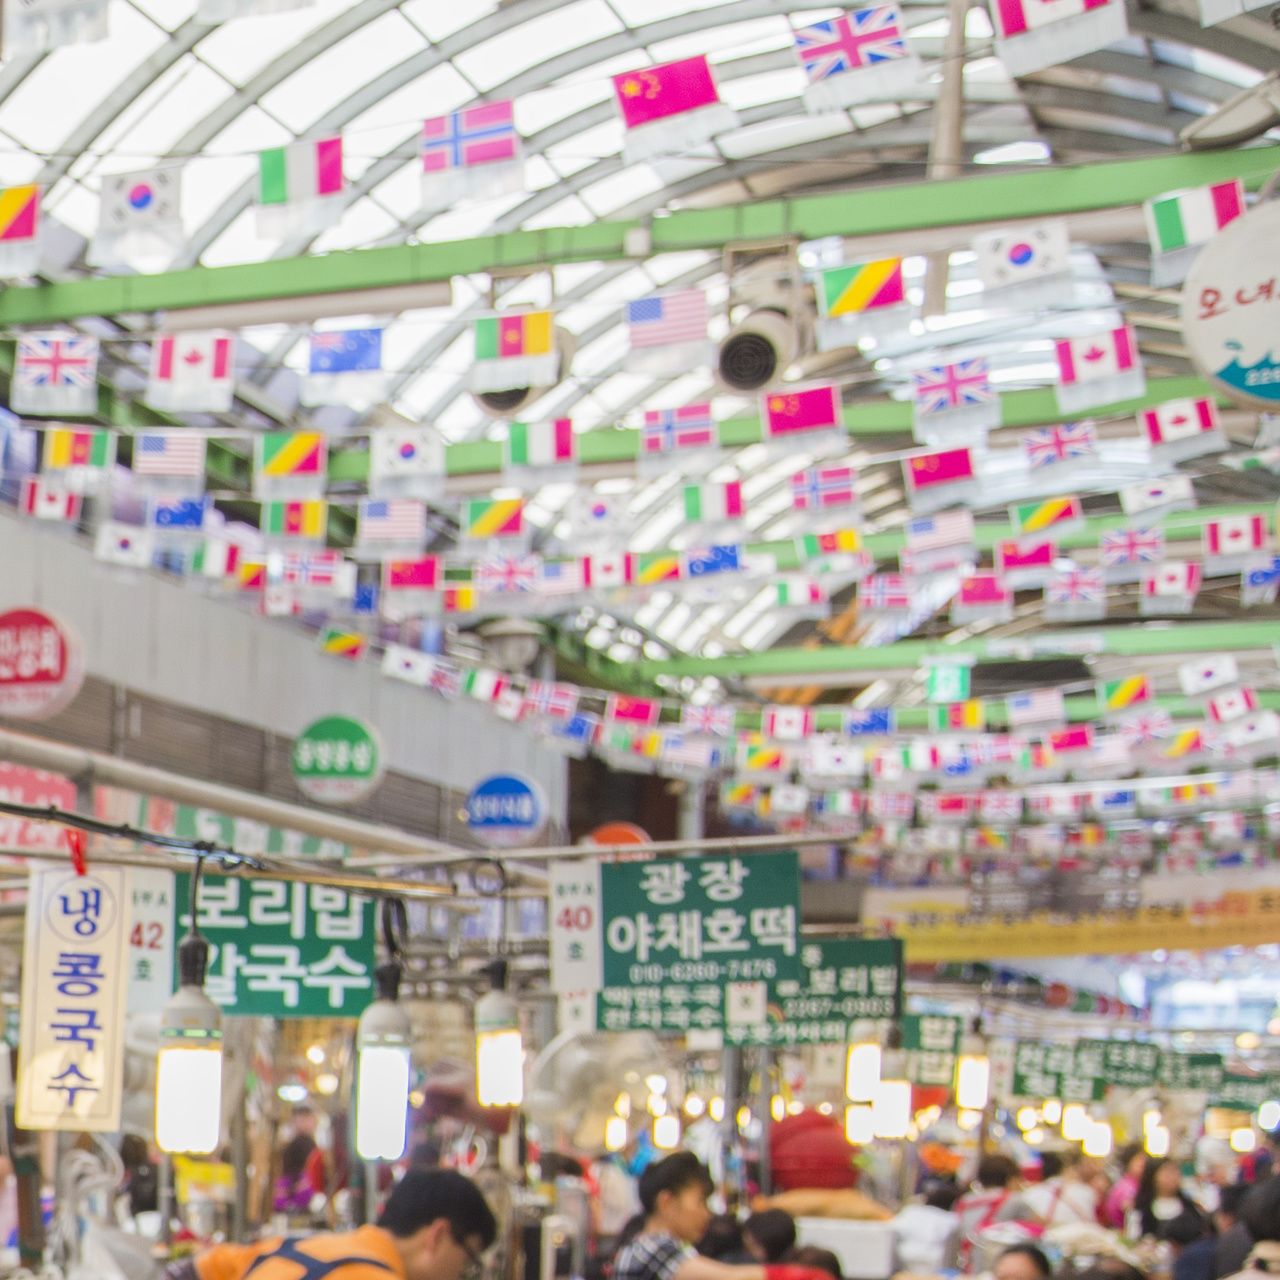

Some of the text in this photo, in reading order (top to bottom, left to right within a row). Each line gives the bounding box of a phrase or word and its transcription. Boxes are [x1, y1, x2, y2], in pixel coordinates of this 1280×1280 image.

[179, 876, 375, 939] 보리밥
[639, 858, 751, 905] 광장
[130, 921, 164, 949] 42
[556, 906, 594, 931] 40
[606, 905, 797, 962] 야채호떡
[46, 888, 107, 1107] 냉콩국수
